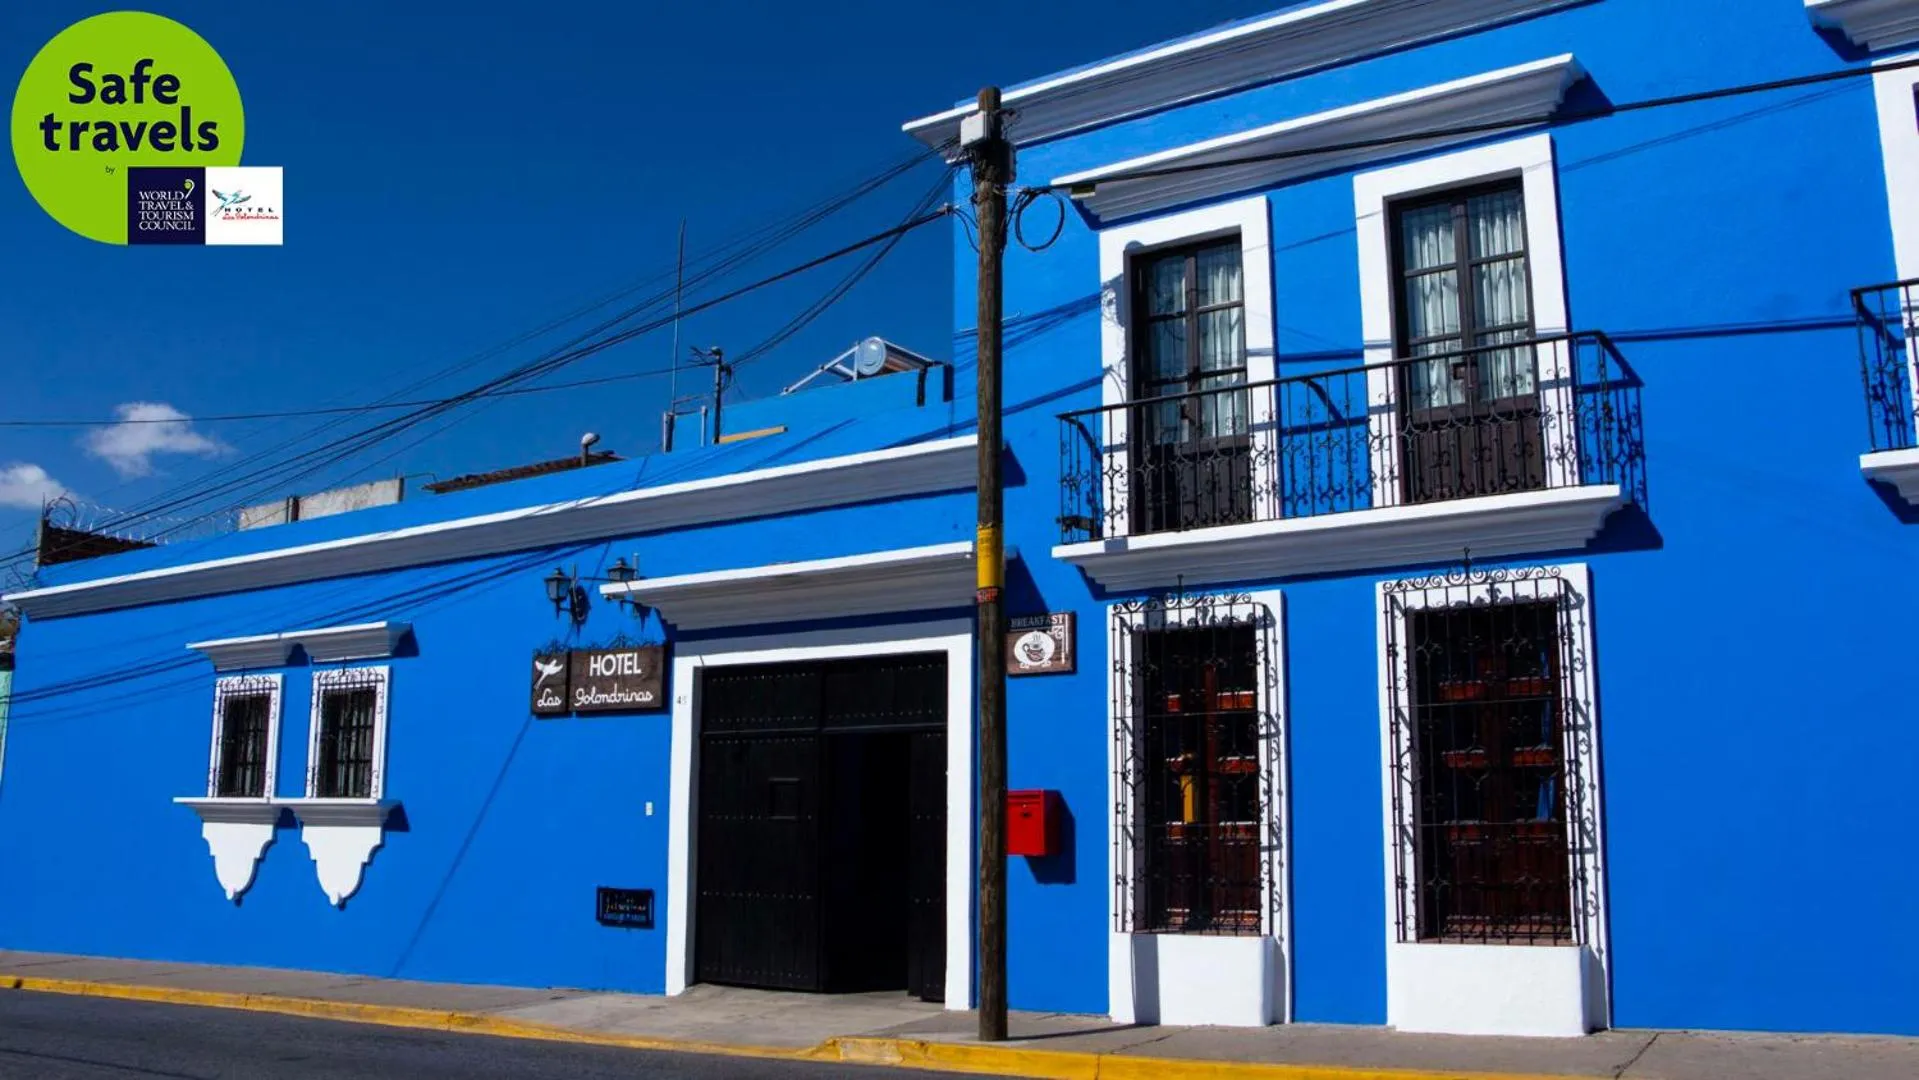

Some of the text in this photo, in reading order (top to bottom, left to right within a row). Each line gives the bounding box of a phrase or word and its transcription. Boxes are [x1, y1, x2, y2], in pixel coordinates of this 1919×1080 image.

[1010, 614, 1064, 628] BREAKFAST
[589, 652, 642, 677] HOTEL
[537, 688, 562, 707] Las
[574, 683, 653, 706] Golondrinas
